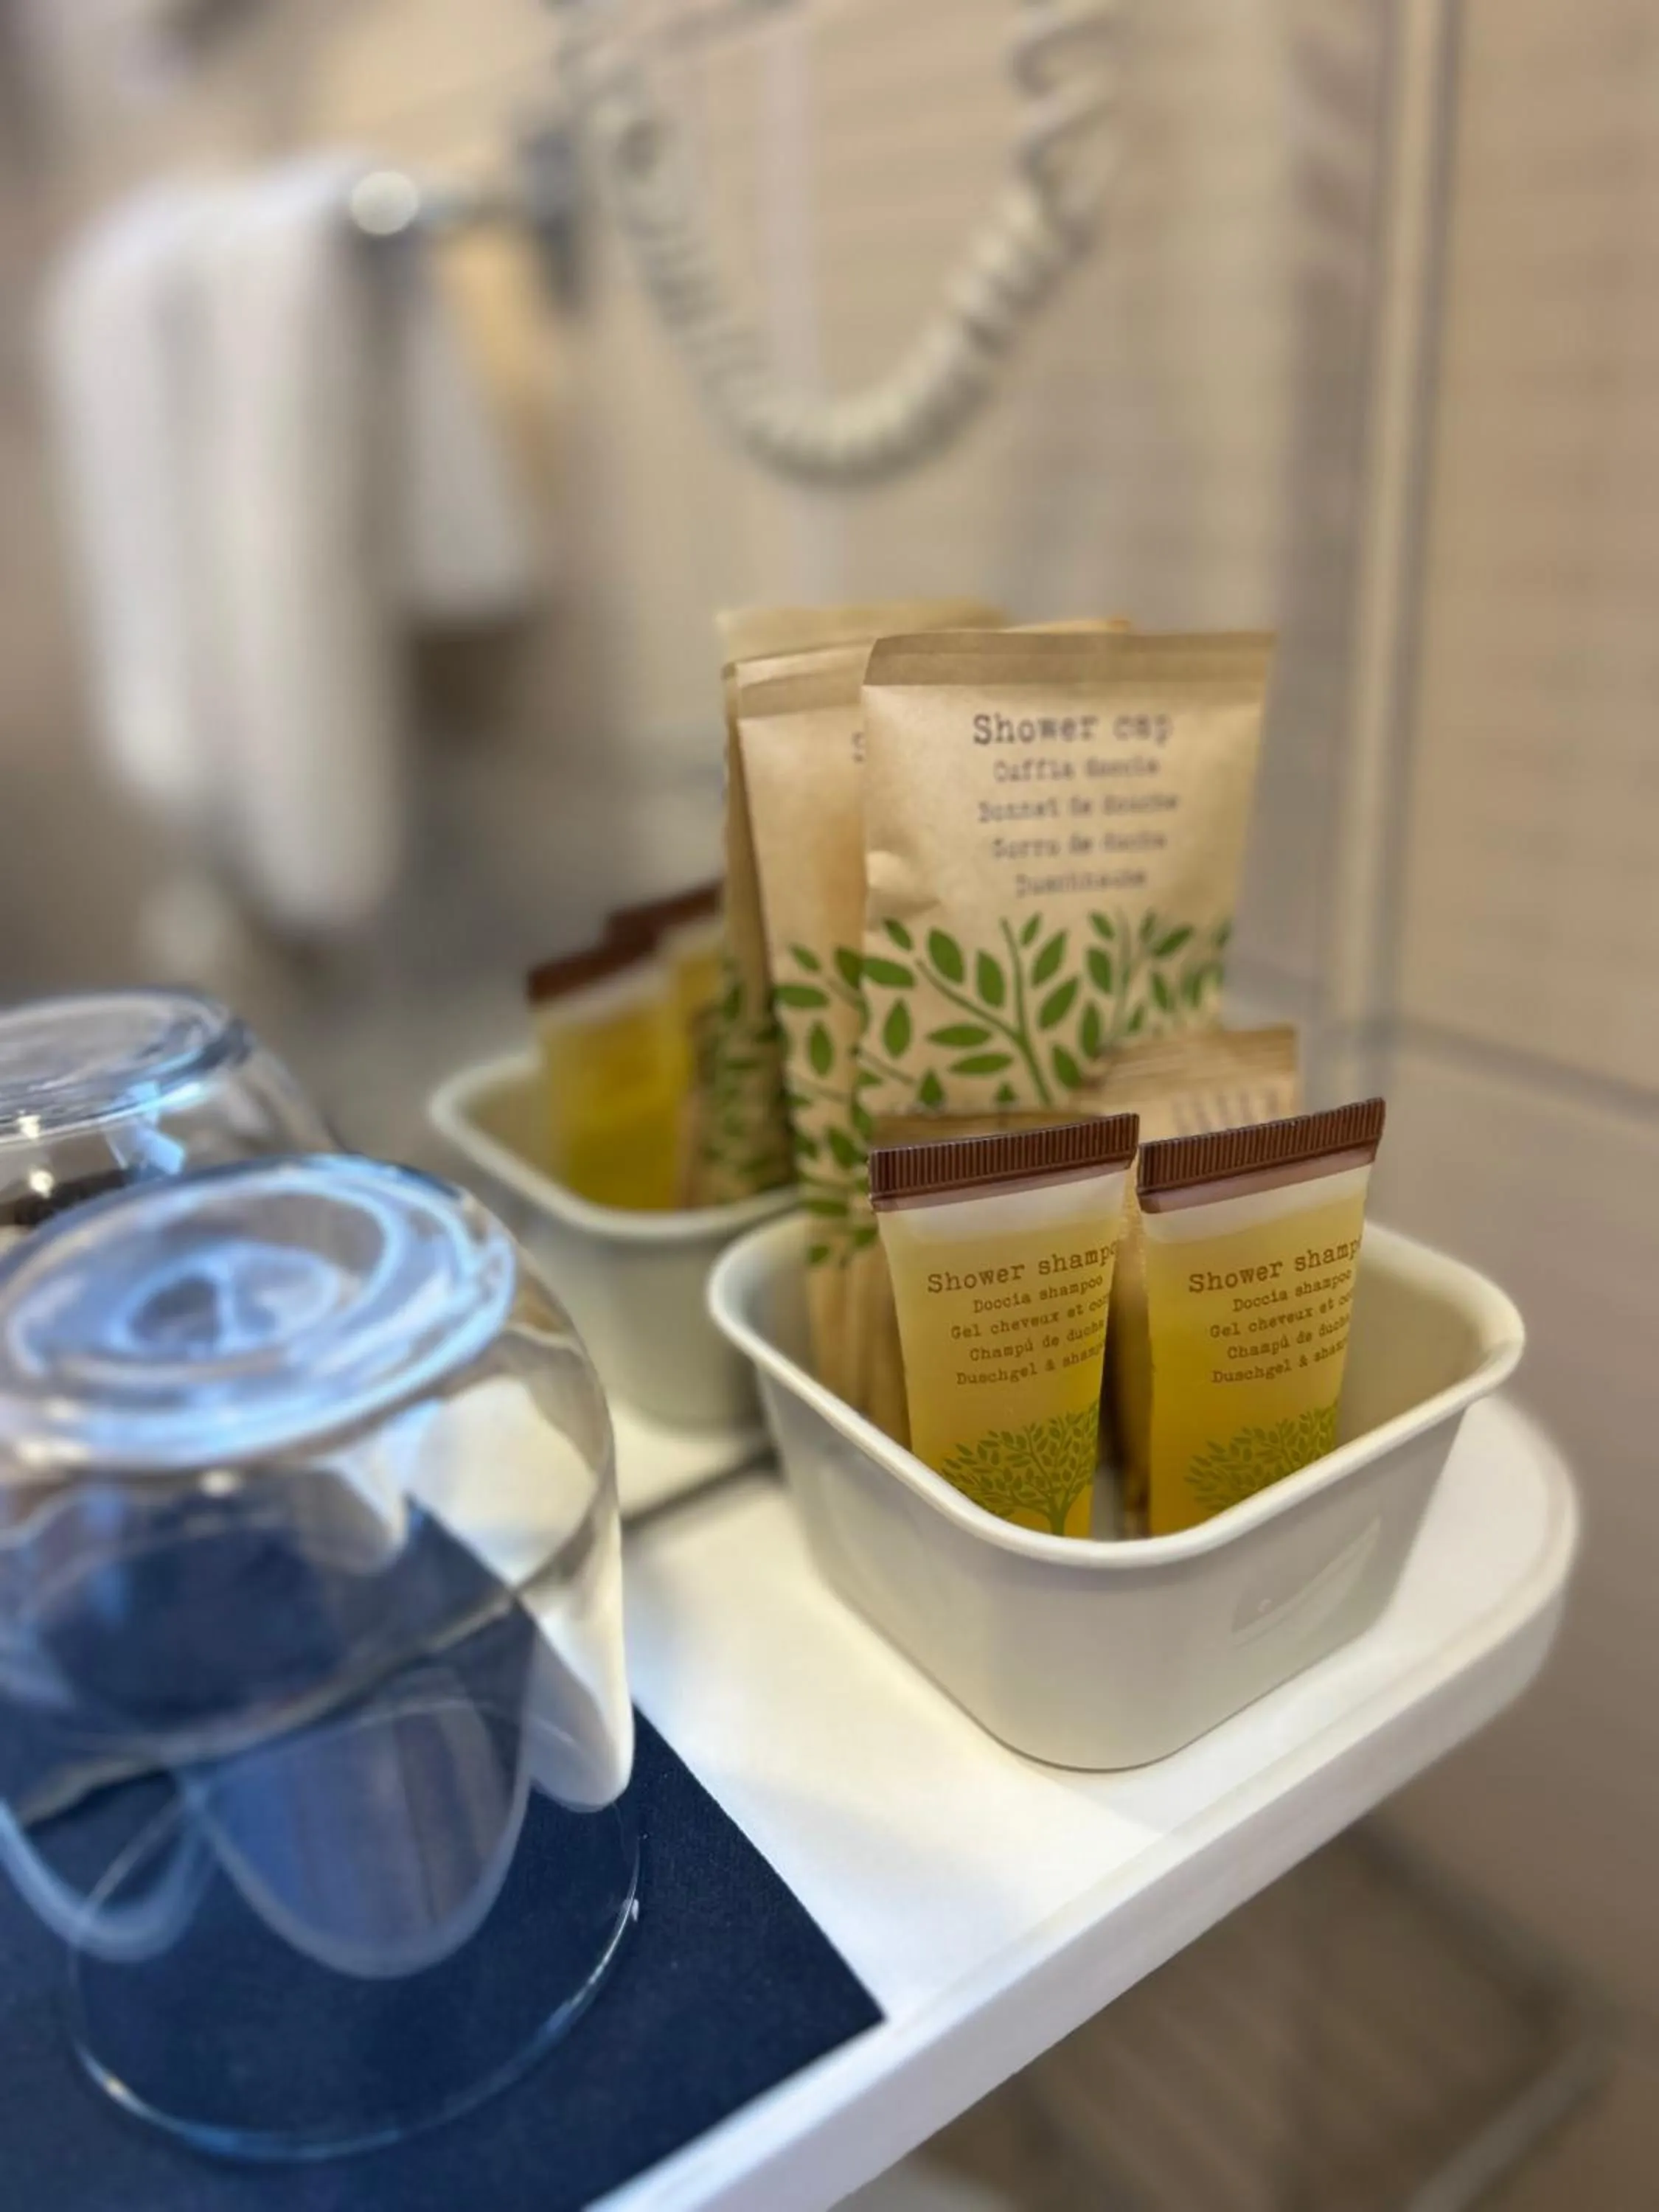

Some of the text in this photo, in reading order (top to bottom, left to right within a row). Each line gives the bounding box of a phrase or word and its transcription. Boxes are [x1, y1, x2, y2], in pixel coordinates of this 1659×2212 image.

[973, 713, 1175, 748] Shower cap
[928, 1263, 1025, 1293] Shower
[1189, 1261, 1283, 1293] Shower
[974, 1274, 1103, 1314] Doccia shampoo
[1233, 1290, 1288, 1312] Doccia
[950, 1324, 981, 1340] Gel
[990, 1311, 1060, 1335] cheveux
[1210, 1323, 1241, 1338] Gel
[1248, 1306, 1313, 1333] cheveux
[1043, 1335, 1060, 1349] de
[1296, 1330, 1312, 1344] de
[956, 1363, 1038, 1385] Duschgel
[1211, 1360, 1292, 1384] Duschgel
